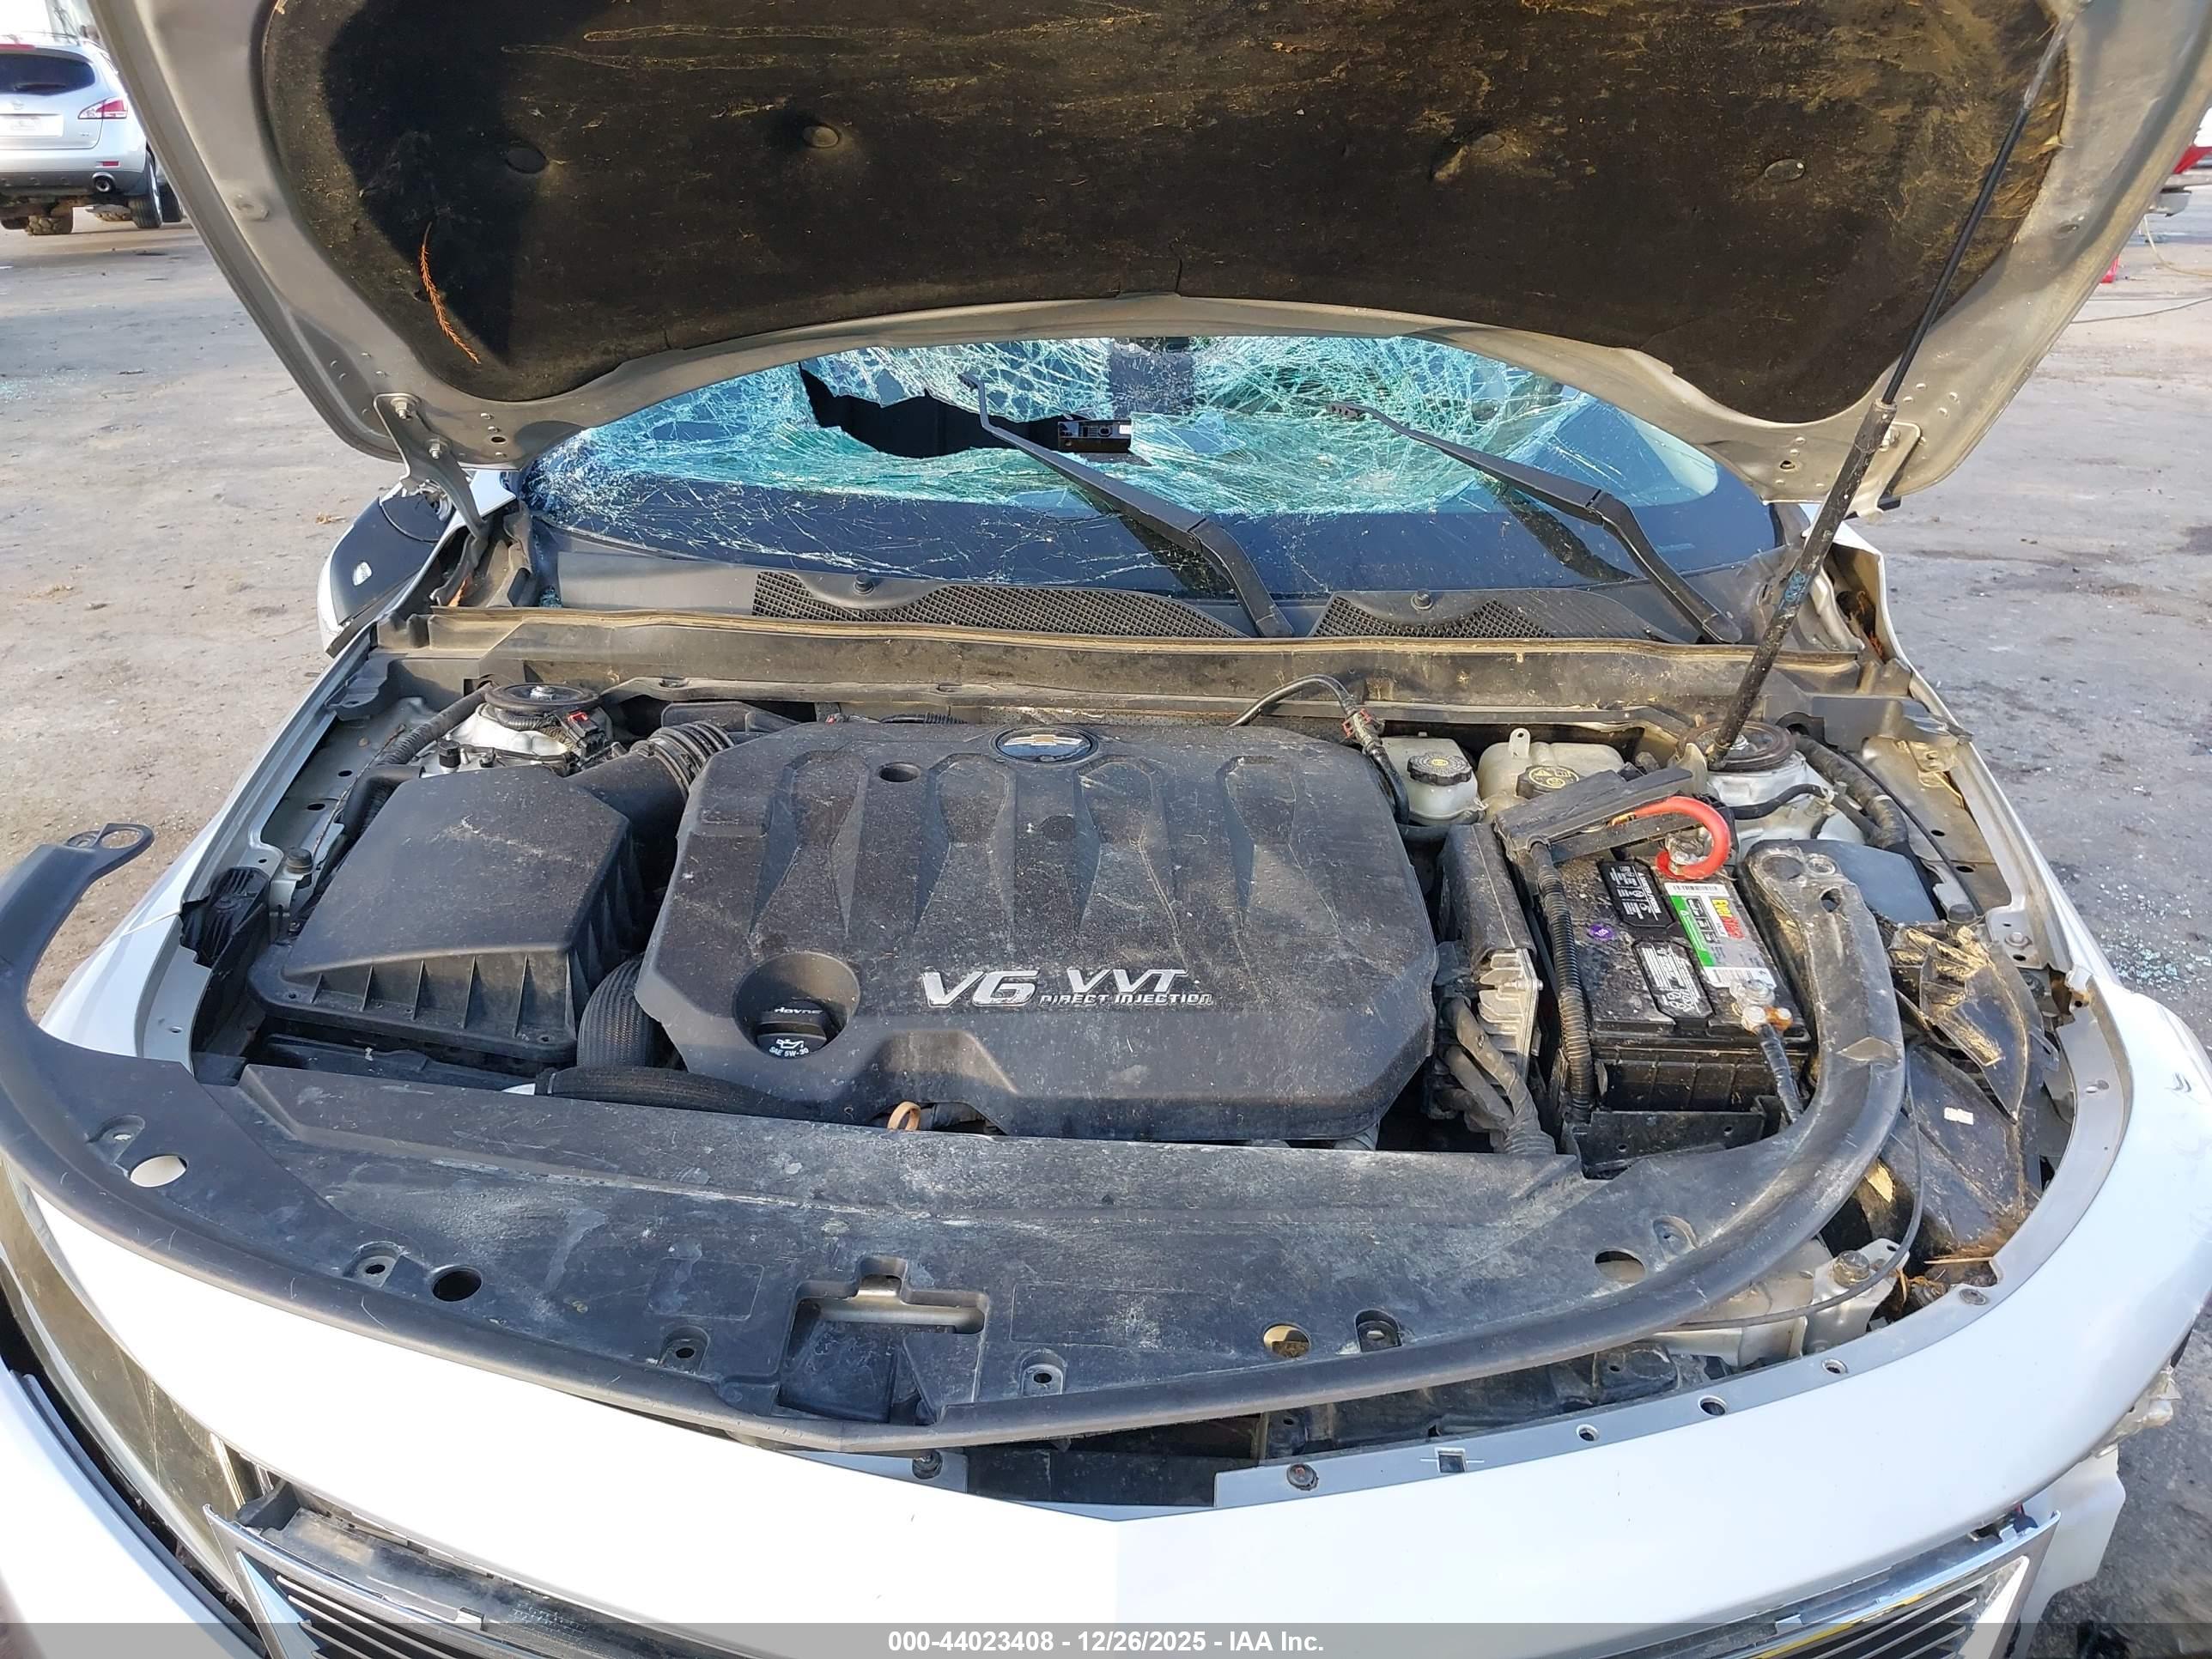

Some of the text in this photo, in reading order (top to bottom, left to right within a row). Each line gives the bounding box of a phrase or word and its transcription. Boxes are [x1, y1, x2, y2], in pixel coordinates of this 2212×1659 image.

[921, 969, 1188, 1007] V6 VVT
[1040, 994, 1213, 1006] DIRECT INJECTION
[769, 1046, 783, 1056] SAE
